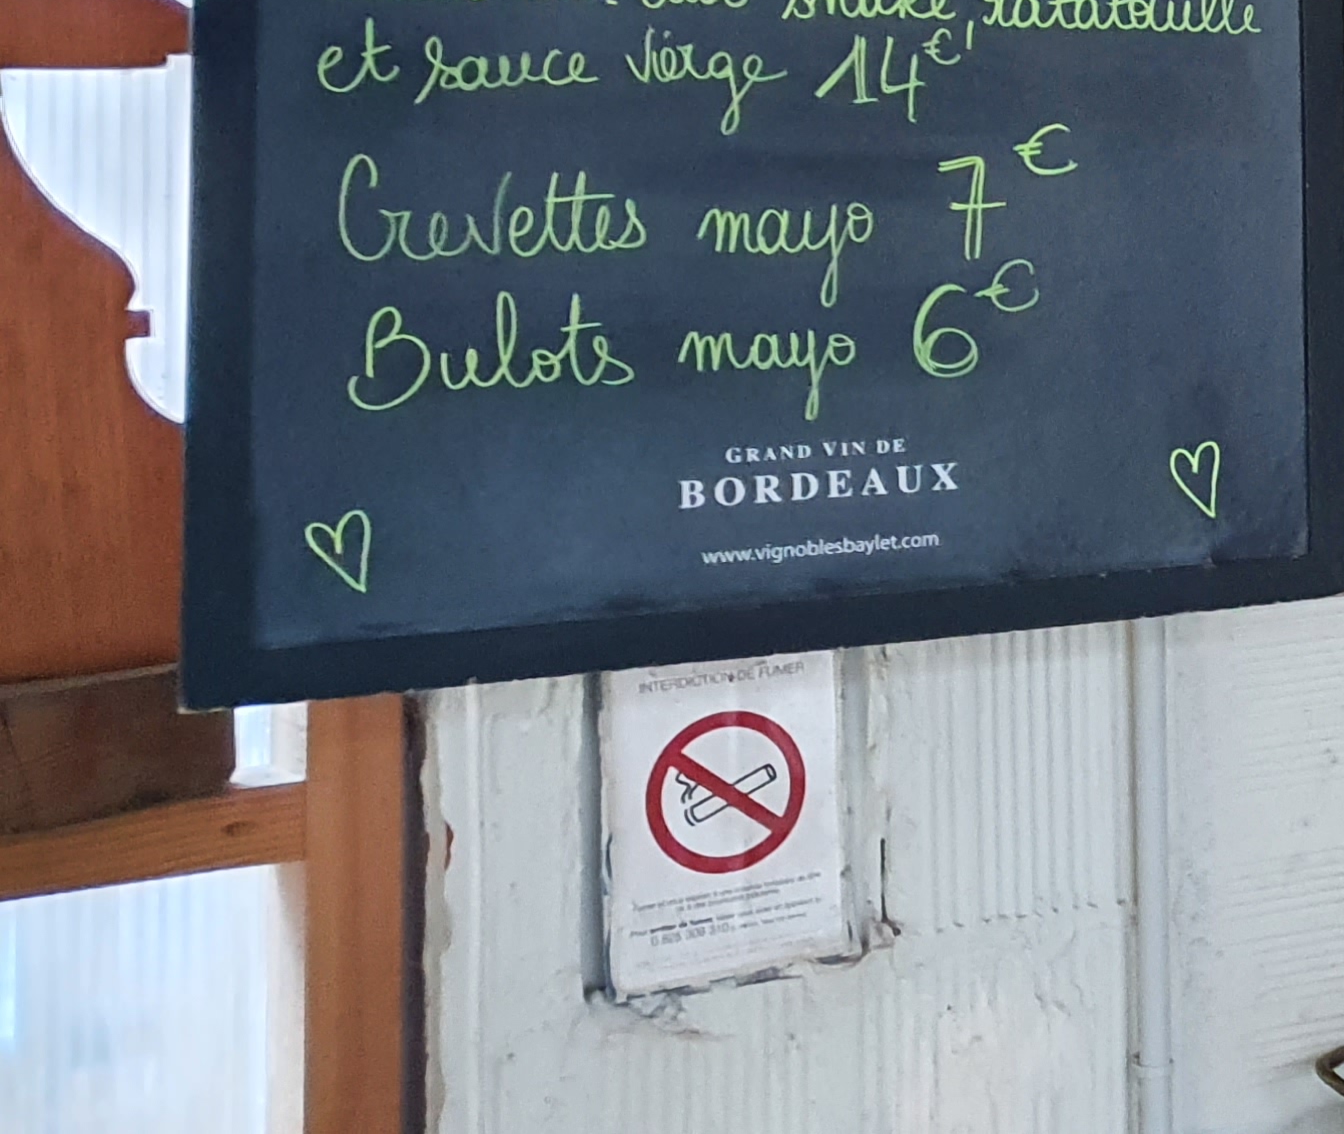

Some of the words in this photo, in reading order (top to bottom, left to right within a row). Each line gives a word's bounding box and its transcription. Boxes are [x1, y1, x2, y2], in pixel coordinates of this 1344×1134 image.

[317, 31, 398, 94] et
[414, 48, 599, 103] sauce
[627, 26, 790, 136] vierge
[337, 153, 648, 262] Crevettes
[697, 198, 876, 307] mayo
[346, 289, 636, 411] Bulots
[678, 323, 858, 420] mayo
[676, 461, 961, 511] BORDEAUX
[724, 442, 810, 465] GRAND
[824, 439, 867, 459] VIN
[876, 435, 907, 456] DE
[701, 529, 941, 568] www.vignoblesbaylet.com
